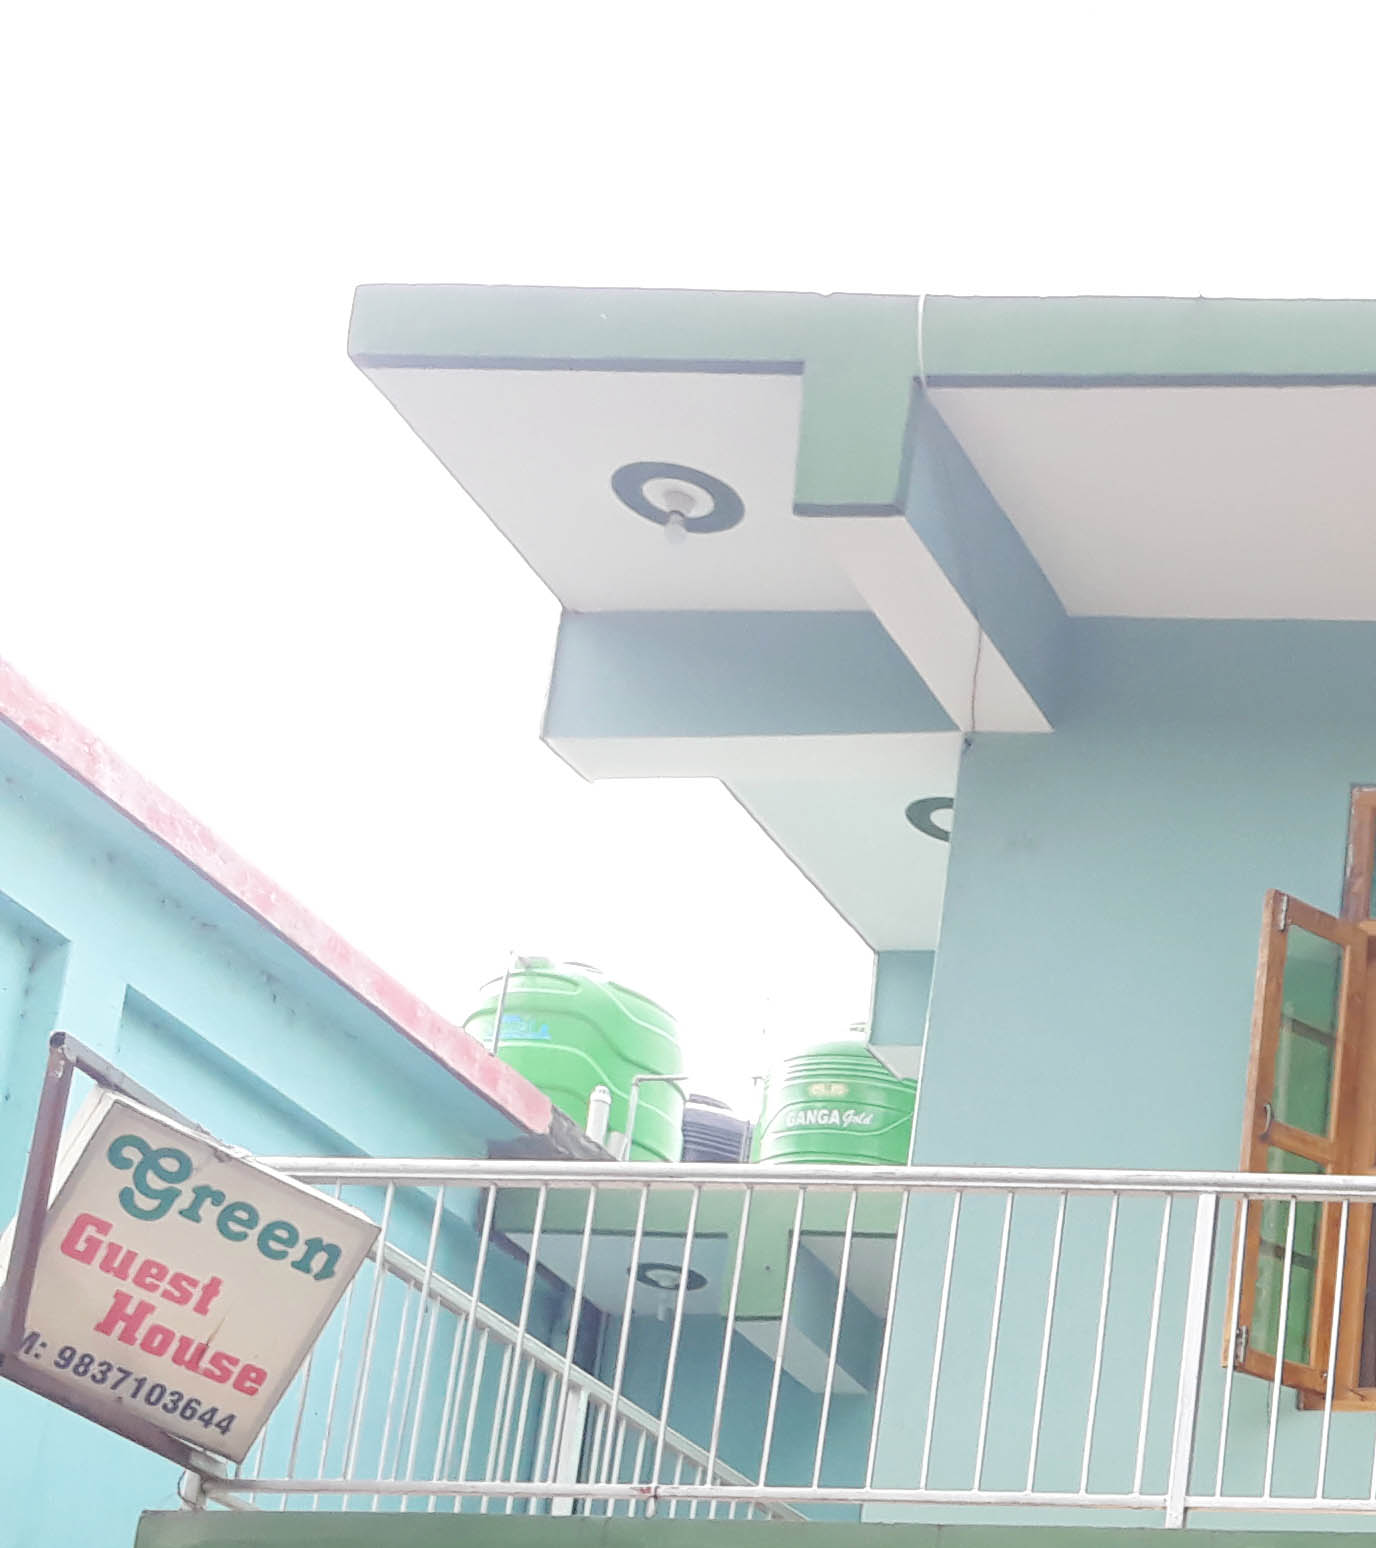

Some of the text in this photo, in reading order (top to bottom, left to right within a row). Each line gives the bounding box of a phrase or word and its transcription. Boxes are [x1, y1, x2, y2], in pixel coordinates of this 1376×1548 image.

[786, 1109, 840, 1127] GANGA
[60, 1213, 223, 1316] Guest
[53, 1345, 236, 1436] 9837103644
[94, 1289, 267, 1396] House
